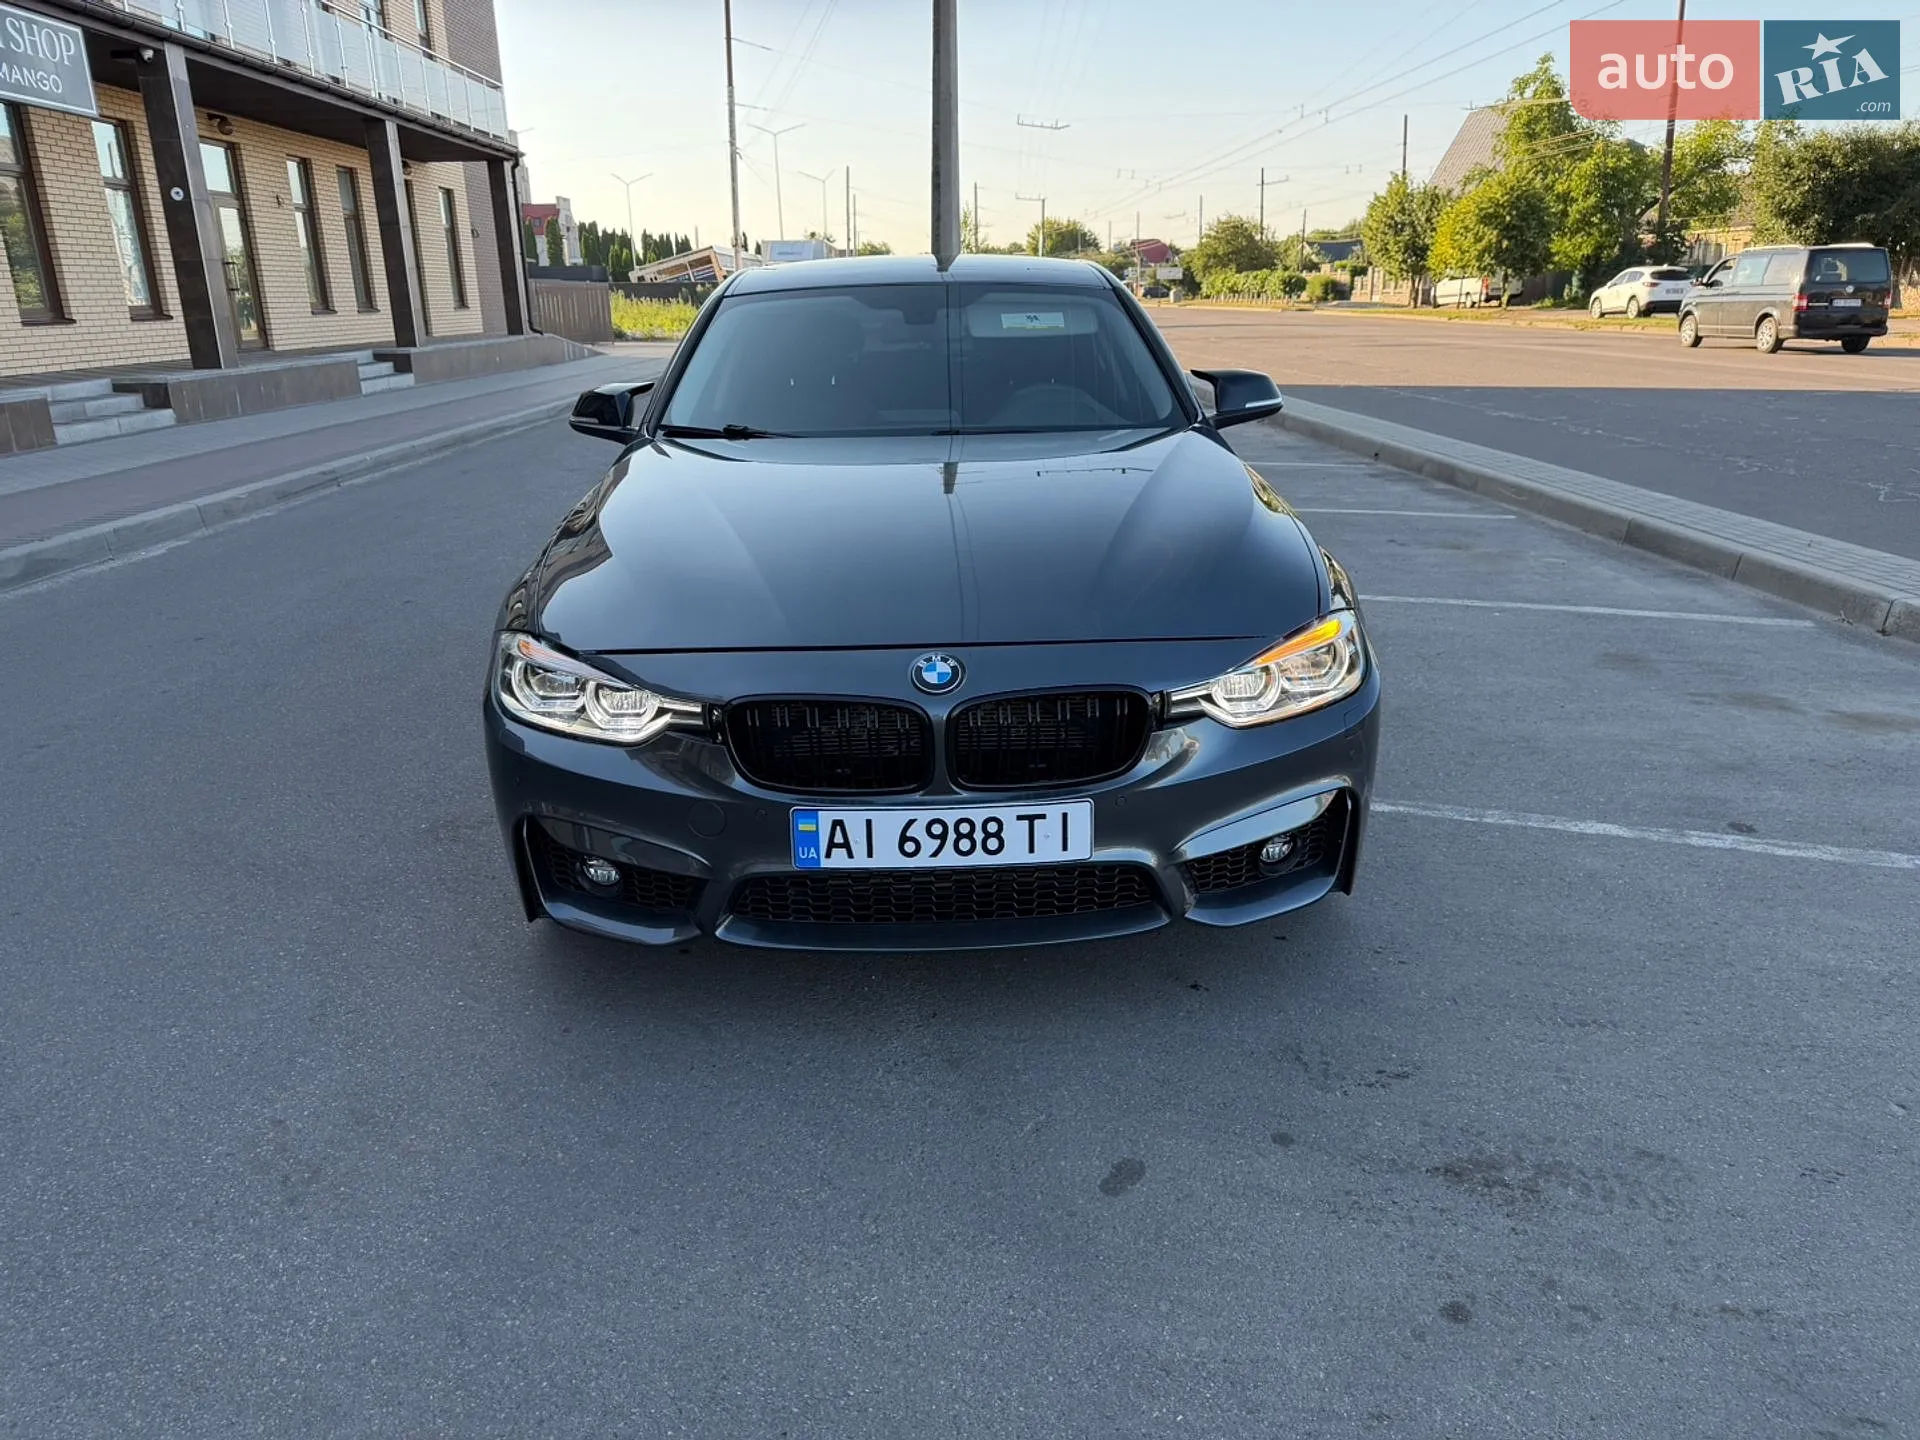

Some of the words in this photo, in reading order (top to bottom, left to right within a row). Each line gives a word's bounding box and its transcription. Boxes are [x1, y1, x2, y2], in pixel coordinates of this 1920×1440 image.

[5, 17, 75, 66] SHOP
[799, 847, 818, 859] UA
[824, 818, 874, 859] AI
[898, 816, 1005, 858] 6988
[1016, 812, 1069, 854] TI
